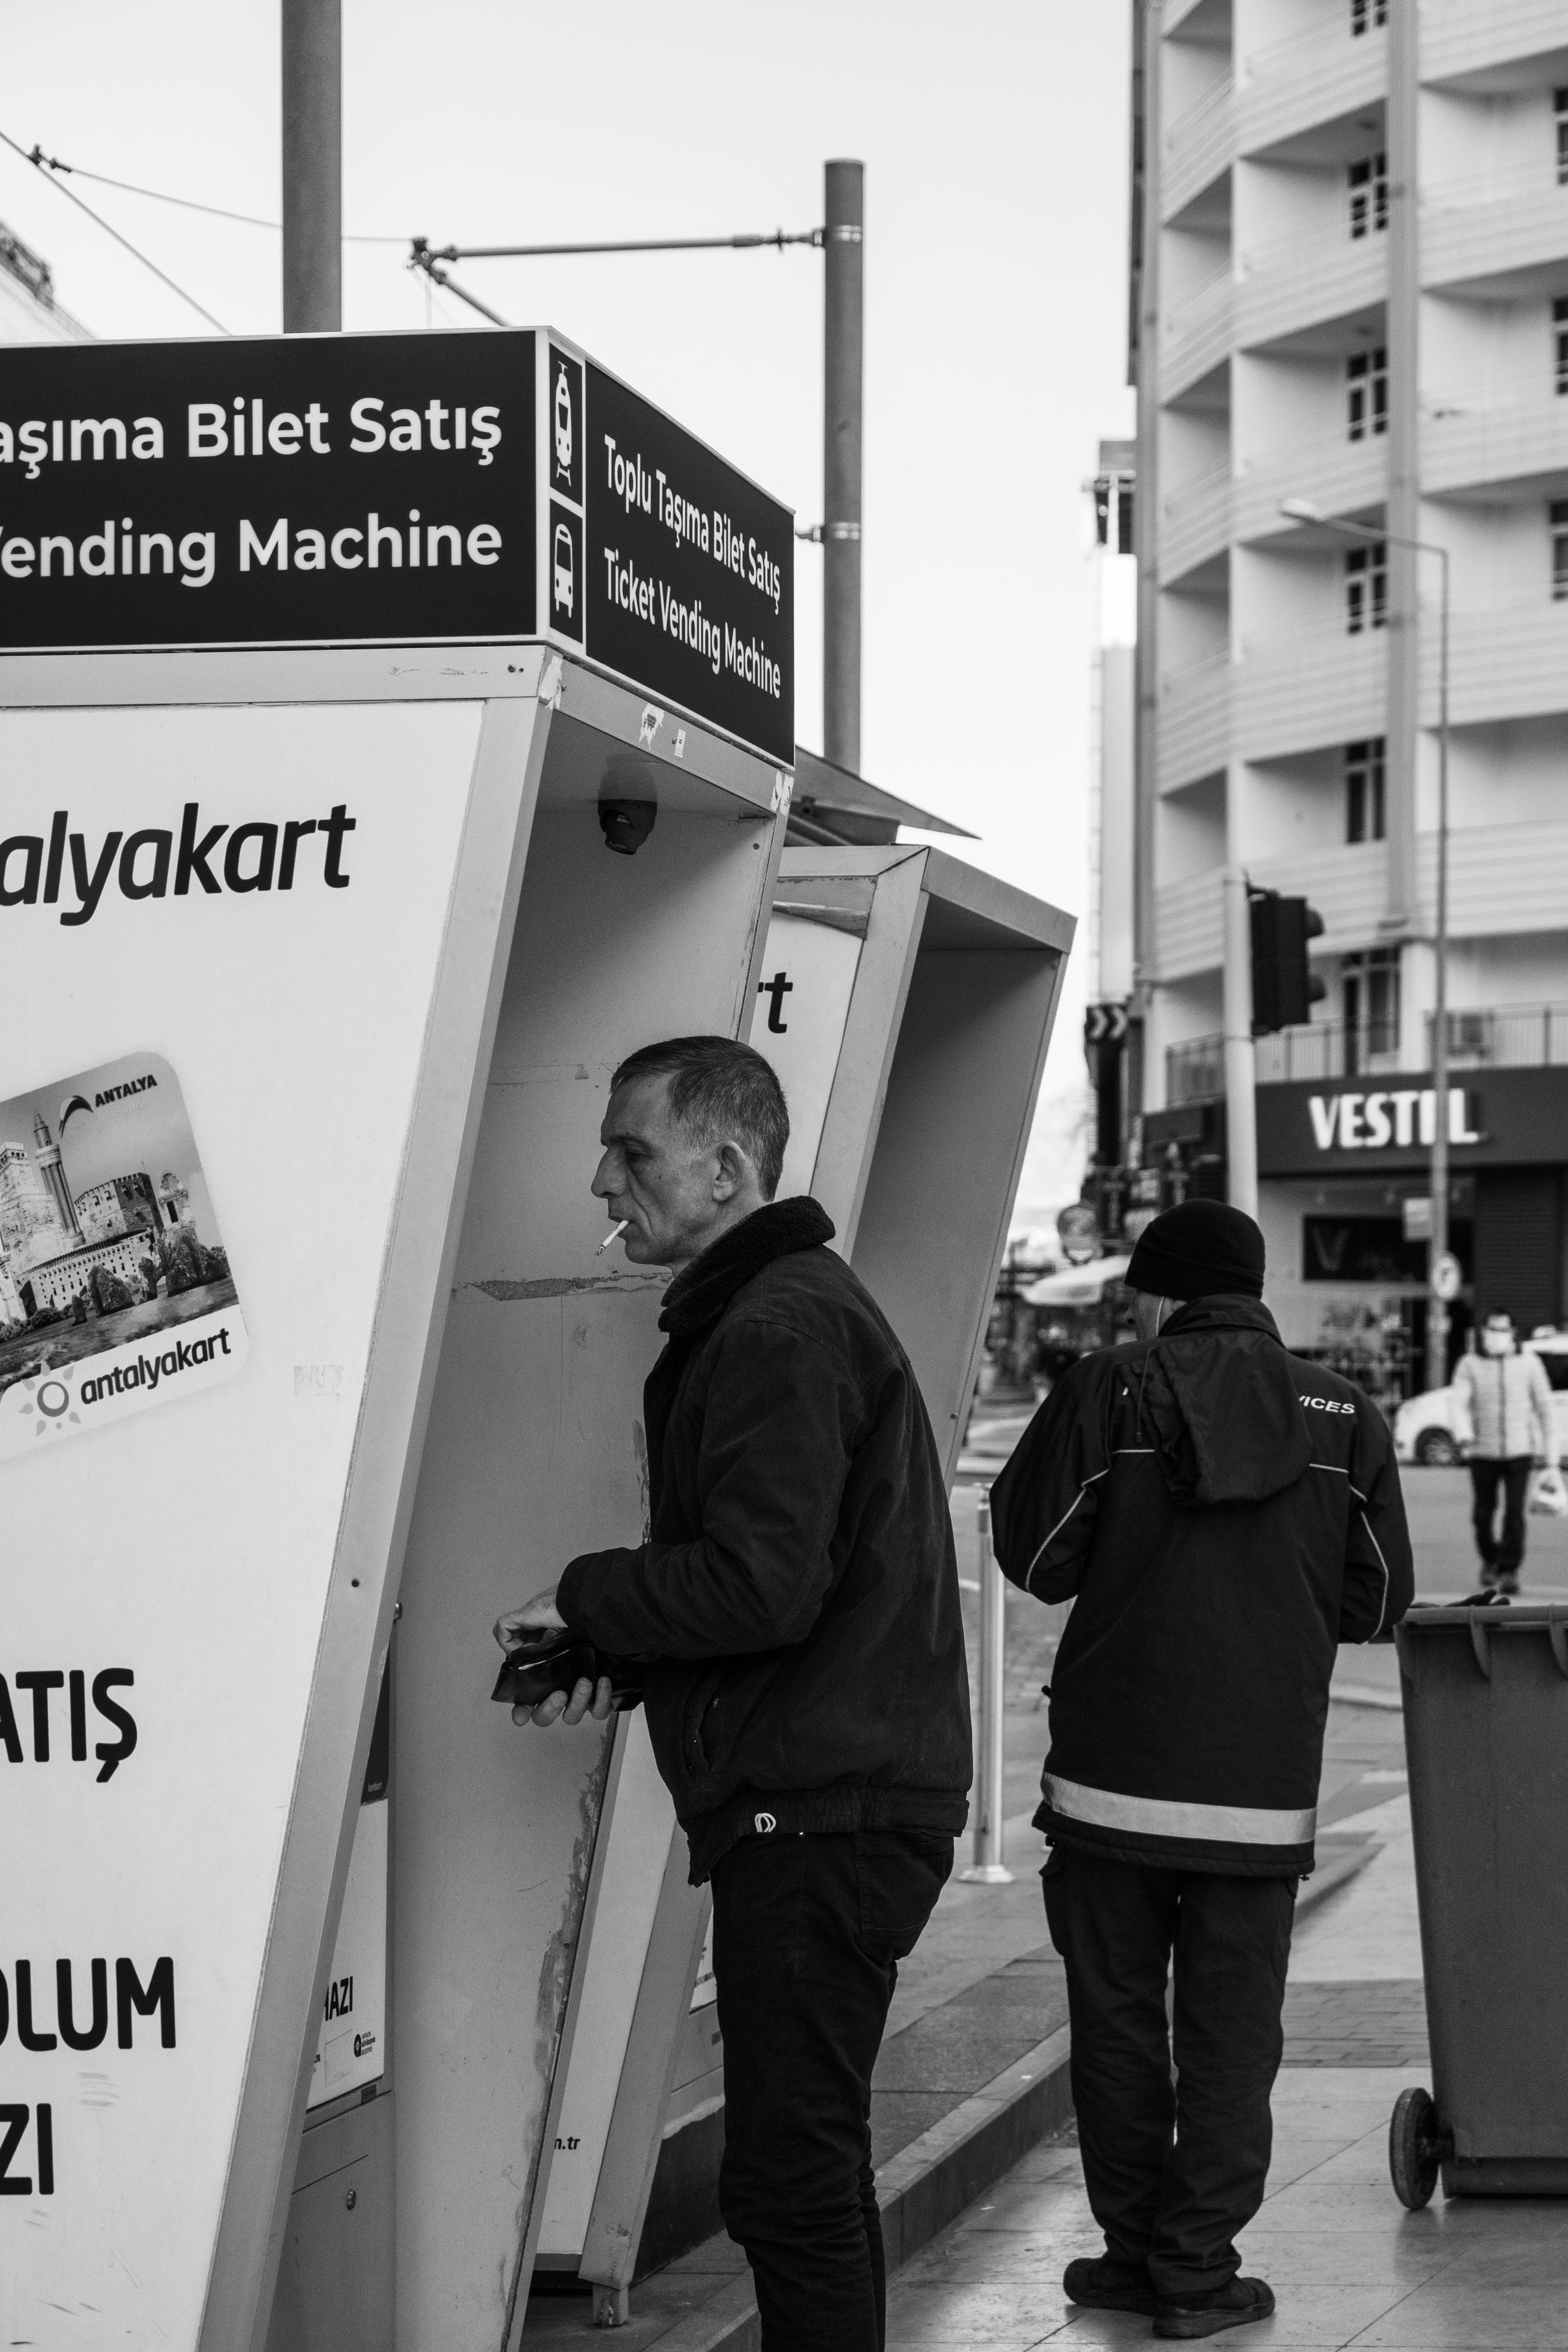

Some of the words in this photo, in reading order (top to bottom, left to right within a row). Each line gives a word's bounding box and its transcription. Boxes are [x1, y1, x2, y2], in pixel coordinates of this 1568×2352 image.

[189, 397, 331, 457] Bilet
[350, 398, 502, 466] Satış
[0, 518, 215, 587] ending
[240, 509, 502, 572] Machine
[604, 434, 652, 514] Toplu
[656, 469, 709, 553] Taşıma
[713, 511, 745, 578] Bilet
[748, 537, 780, 615] Satış
[604, 548, 655, 625] Ticket
[659, 581, 720, 674] Vending
[725, 622, 780, 699] Machine
[0, 802, 356, 926] alyakart
[95, 1074, 158, 1108] ANTALYA
[80, 1328, 231, 1405] antalyakart
[0, 1956, 176, 2052] LUM
[0, 2103, 54, 2195] ZI
